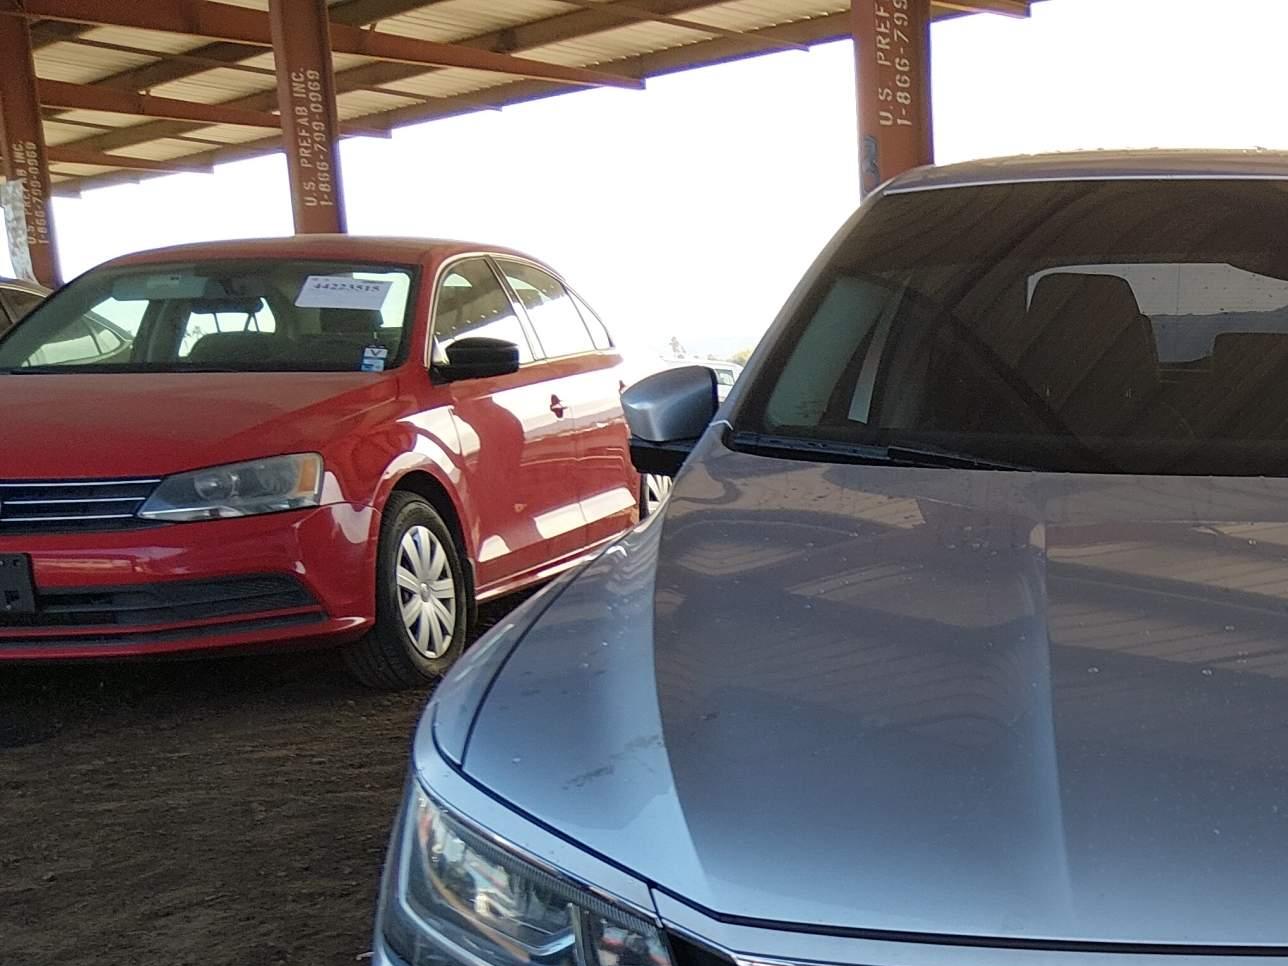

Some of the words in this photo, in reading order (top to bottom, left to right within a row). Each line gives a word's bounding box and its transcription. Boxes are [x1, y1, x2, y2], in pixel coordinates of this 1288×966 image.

[291, 67, 307, 98] INC.
[294, 106, 313, 168] PREFAB
[306, 70, 333, 206] 1-866-799-0969
